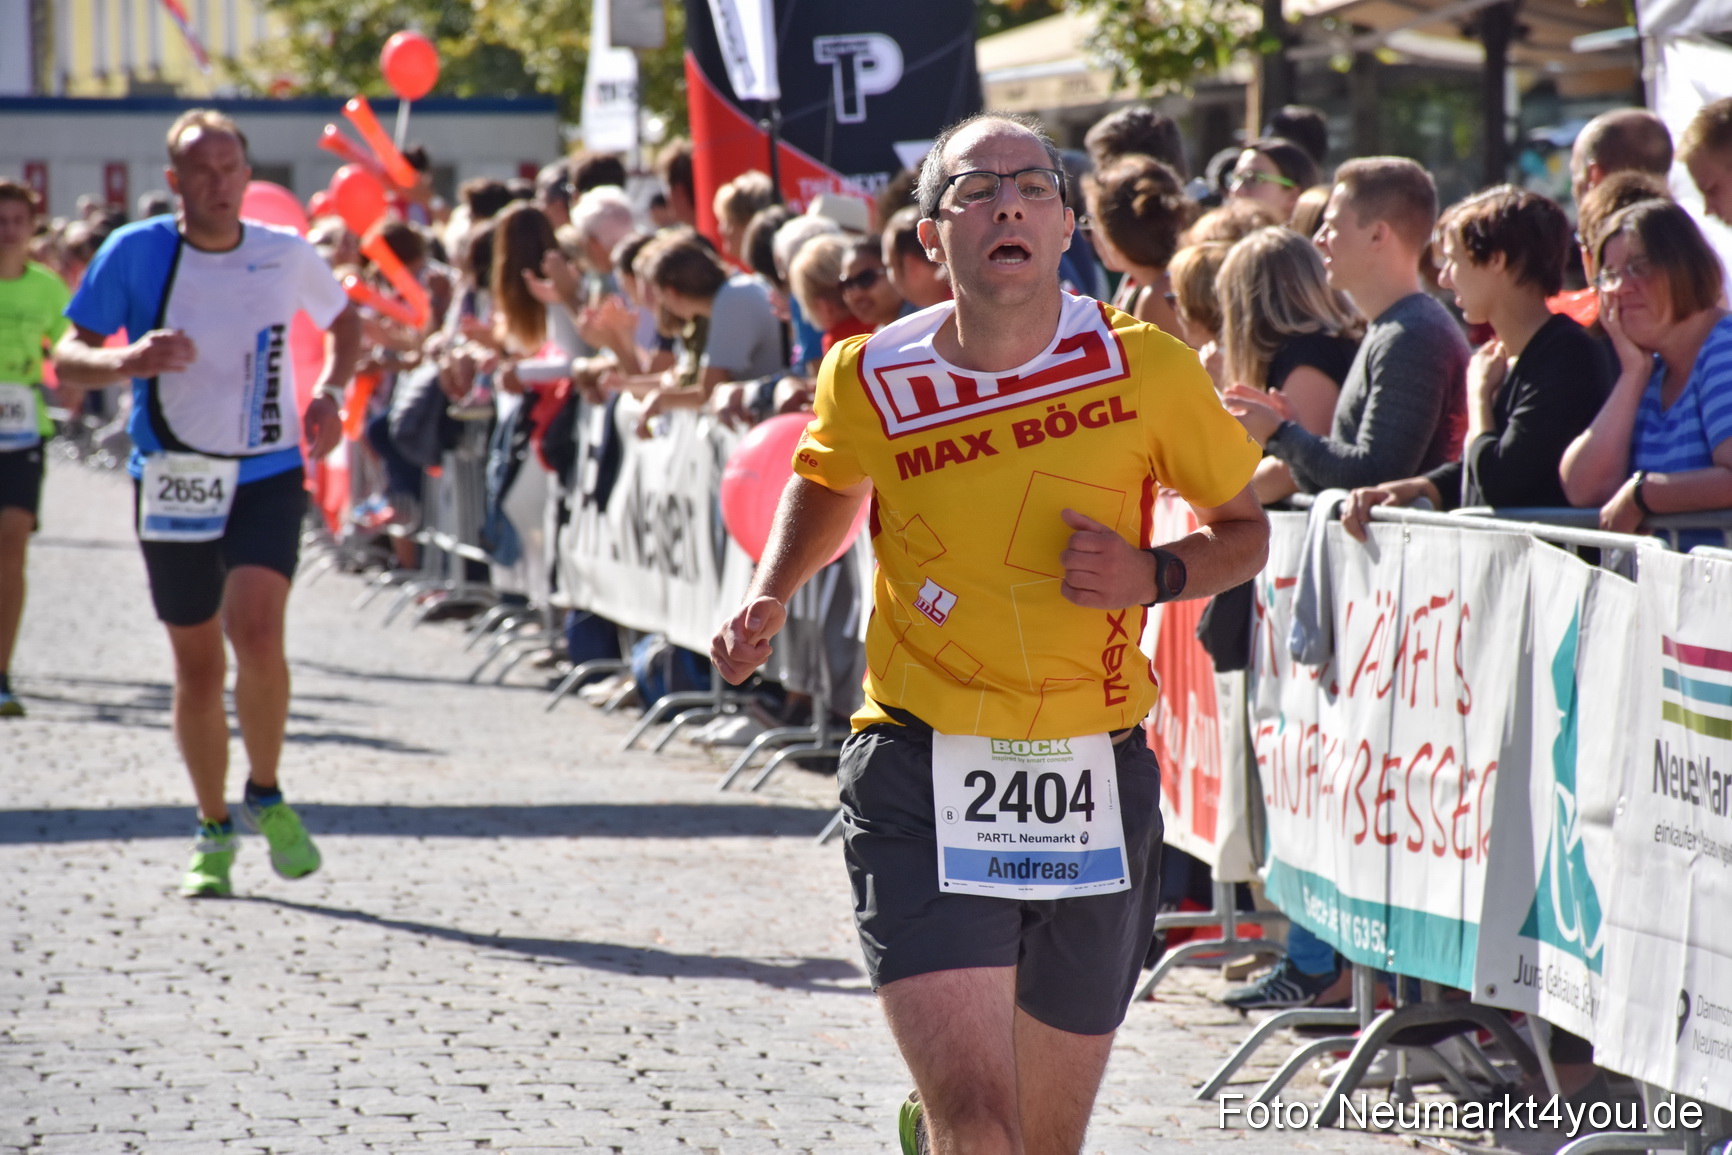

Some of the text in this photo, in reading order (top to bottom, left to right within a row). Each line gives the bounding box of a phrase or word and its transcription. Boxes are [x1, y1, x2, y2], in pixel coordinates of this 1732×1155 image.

[261, 324, 286, 444] HUBER
[895, 395, 1137, 481] MAX BÖGL
[158, 475, 224, 503] 2654
[991, 737, 1073, 756] BOCK
[991, 755, 1017, 763] inspired
[1018, 756, 1025, 764] by
[1046, 755, 1074, 763] concepts
[964, 769, 1095, 824] 2404
[946, 810, 954, 820] B
[977, 832, 1076, 844] PARTL Neumarkt
[987, 856, 1079, 880] Andreas
[1513, 955, 1543, 990] Jura
